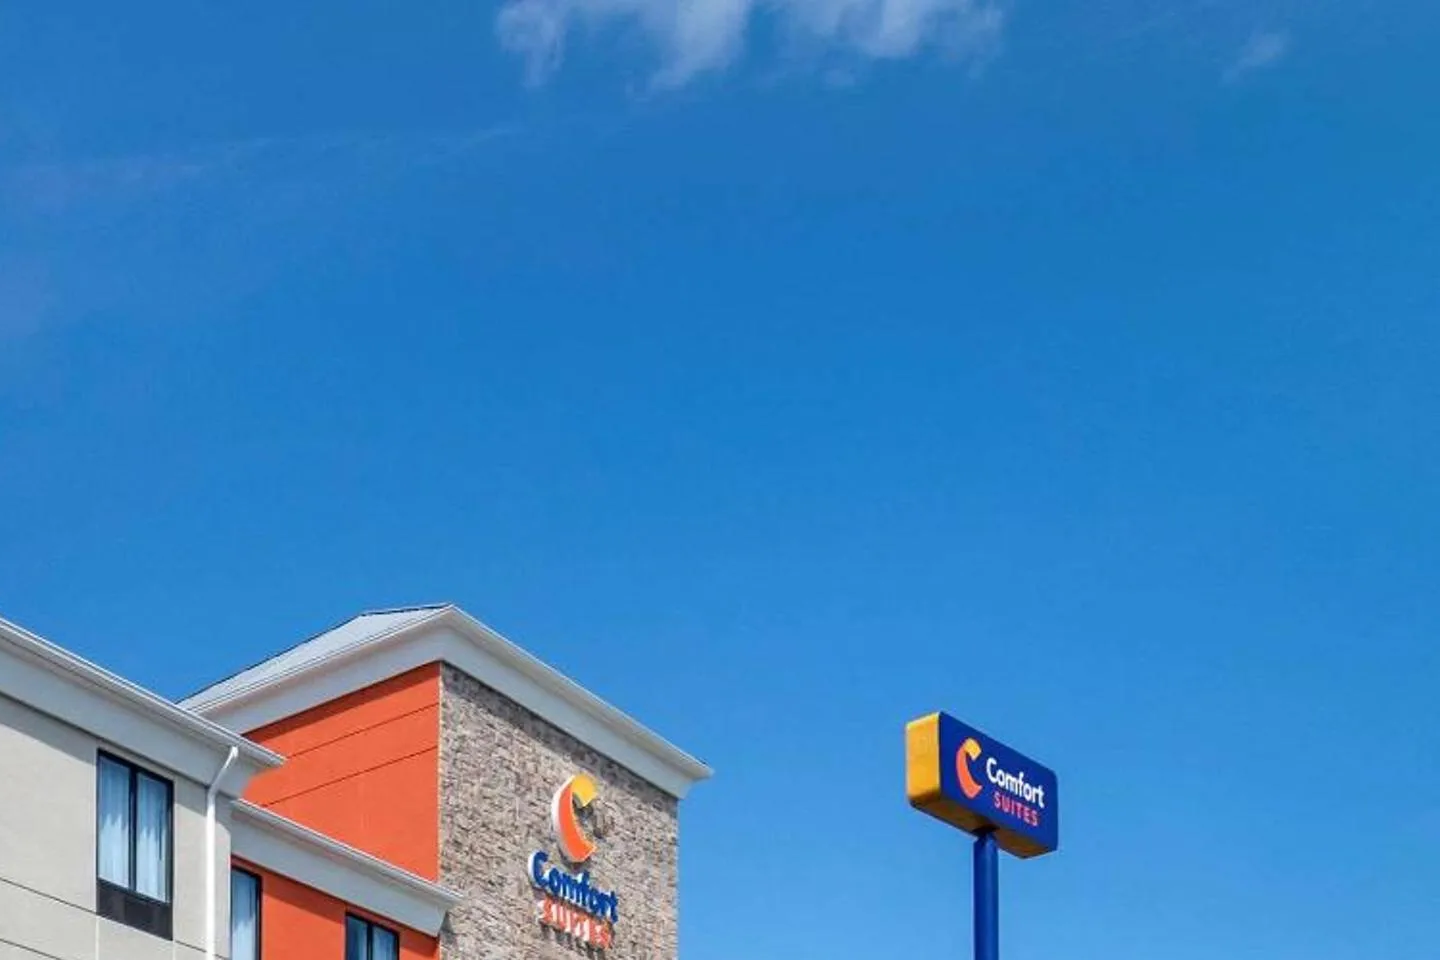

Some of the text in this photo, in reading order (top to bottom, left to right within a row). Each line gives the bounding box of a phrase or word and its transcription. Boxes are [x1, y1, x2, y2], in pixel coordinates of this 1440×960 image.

[986, 757, 1045, 808] Comfort
[994, 791, 1038, 826] SUITES
[531, 850, 619, 924] Comfort
[537, 894, 614, 949] SUITES
